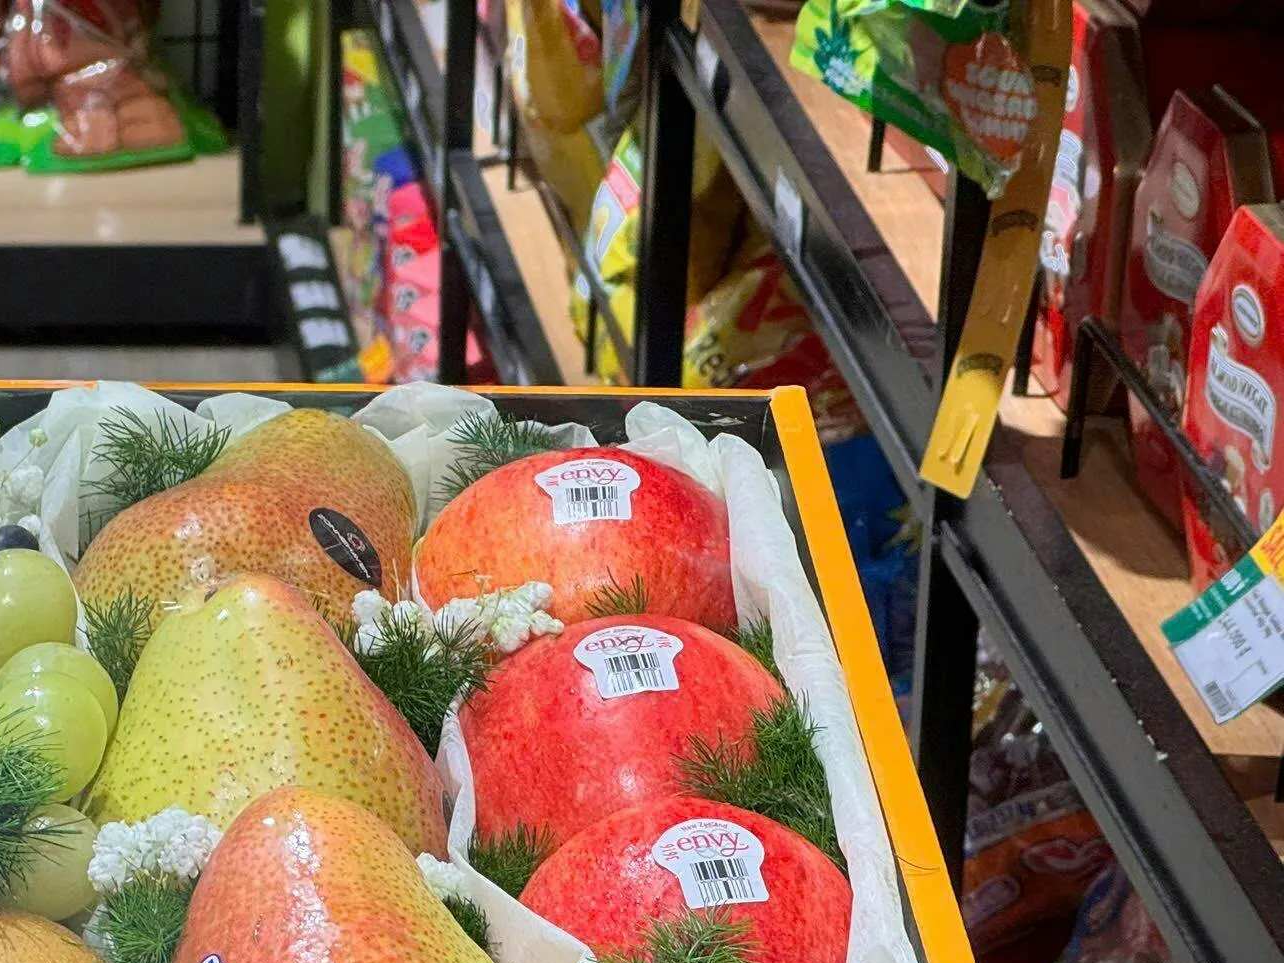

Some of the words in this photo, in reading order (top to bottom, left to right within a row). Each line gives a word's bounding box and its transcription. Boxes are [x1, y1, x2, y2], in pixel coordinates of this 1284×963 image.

[560, 468, 628, 486] envy
[584, 634, 655, 654] envy
[676, 832, 750, 858] envy
